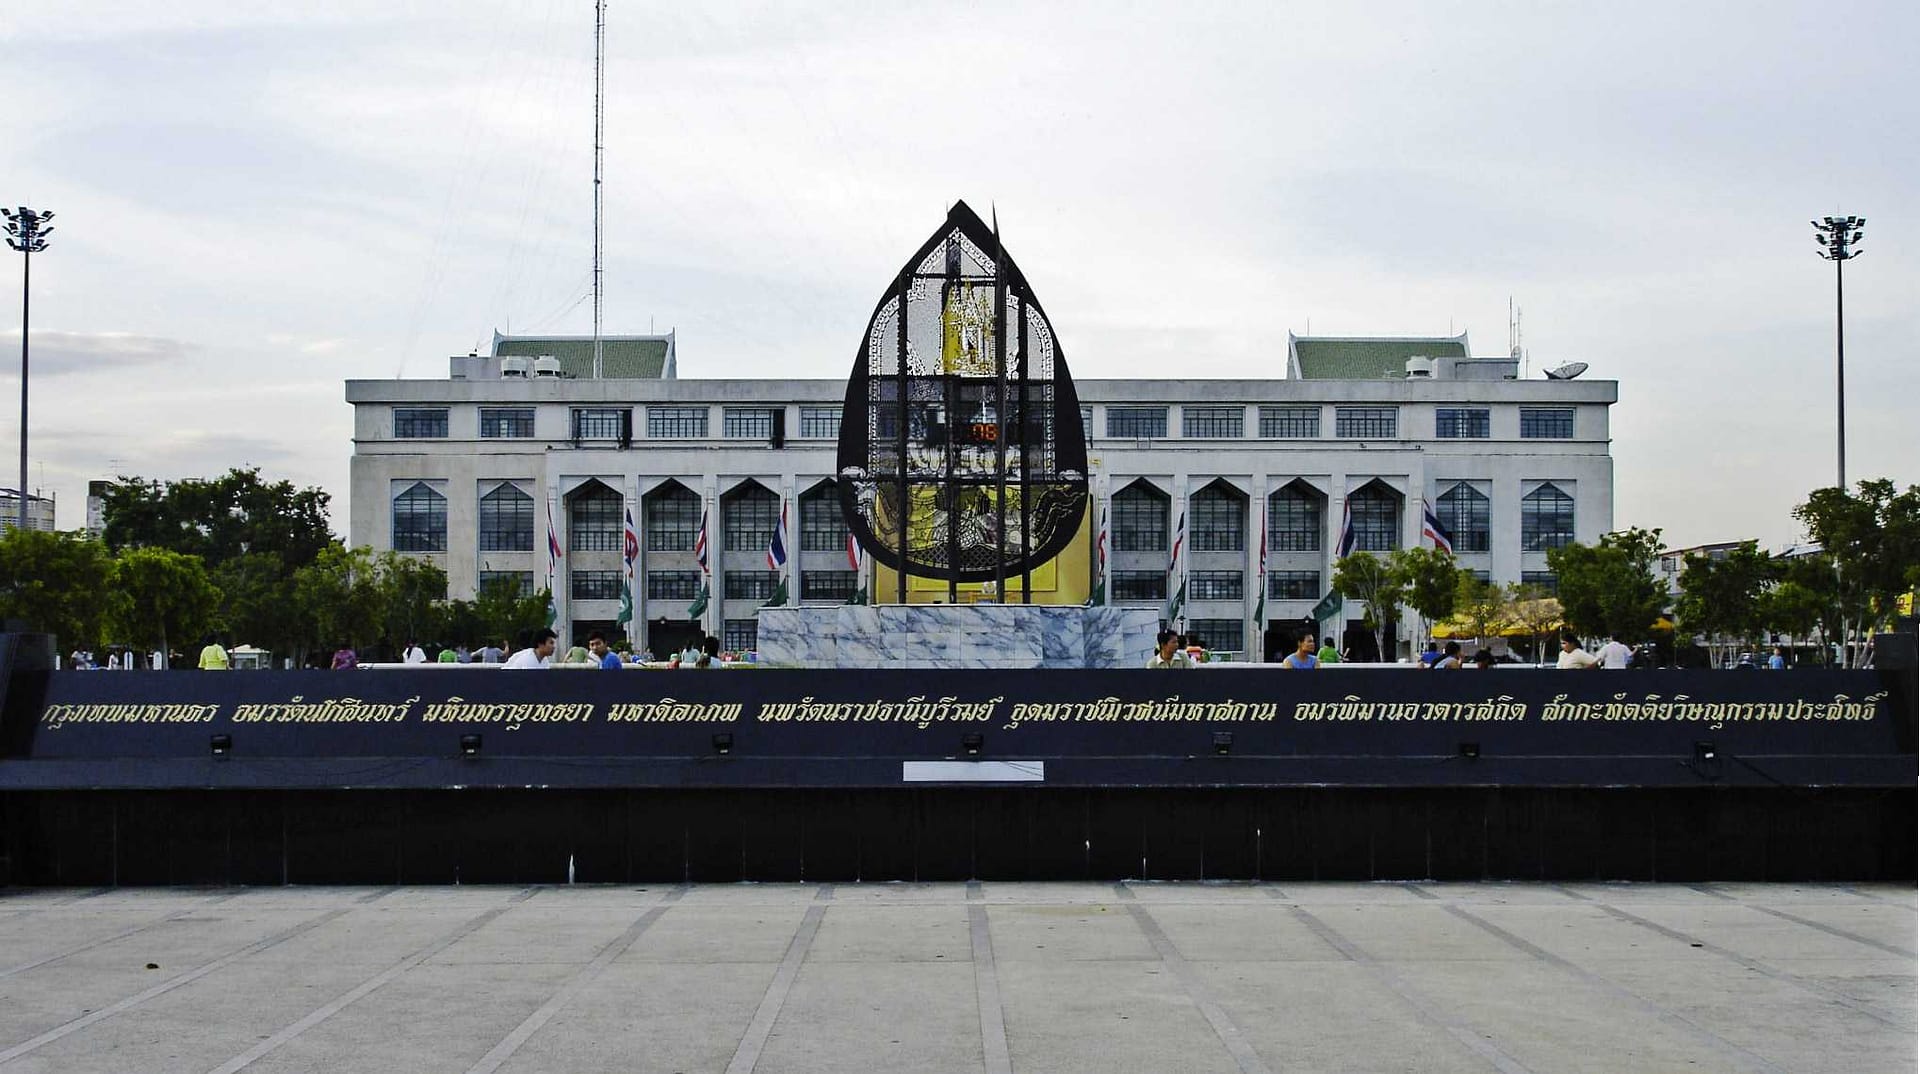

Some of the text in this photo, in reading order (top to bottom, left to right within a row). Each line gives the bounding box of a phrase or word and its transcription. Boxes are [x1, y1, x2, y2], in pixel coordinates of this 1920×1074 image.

[606, 697, 743, 722] มหาดิลกภพ
[1293, 694, 1528, 721] อมรพิมานอวตารสถิต
